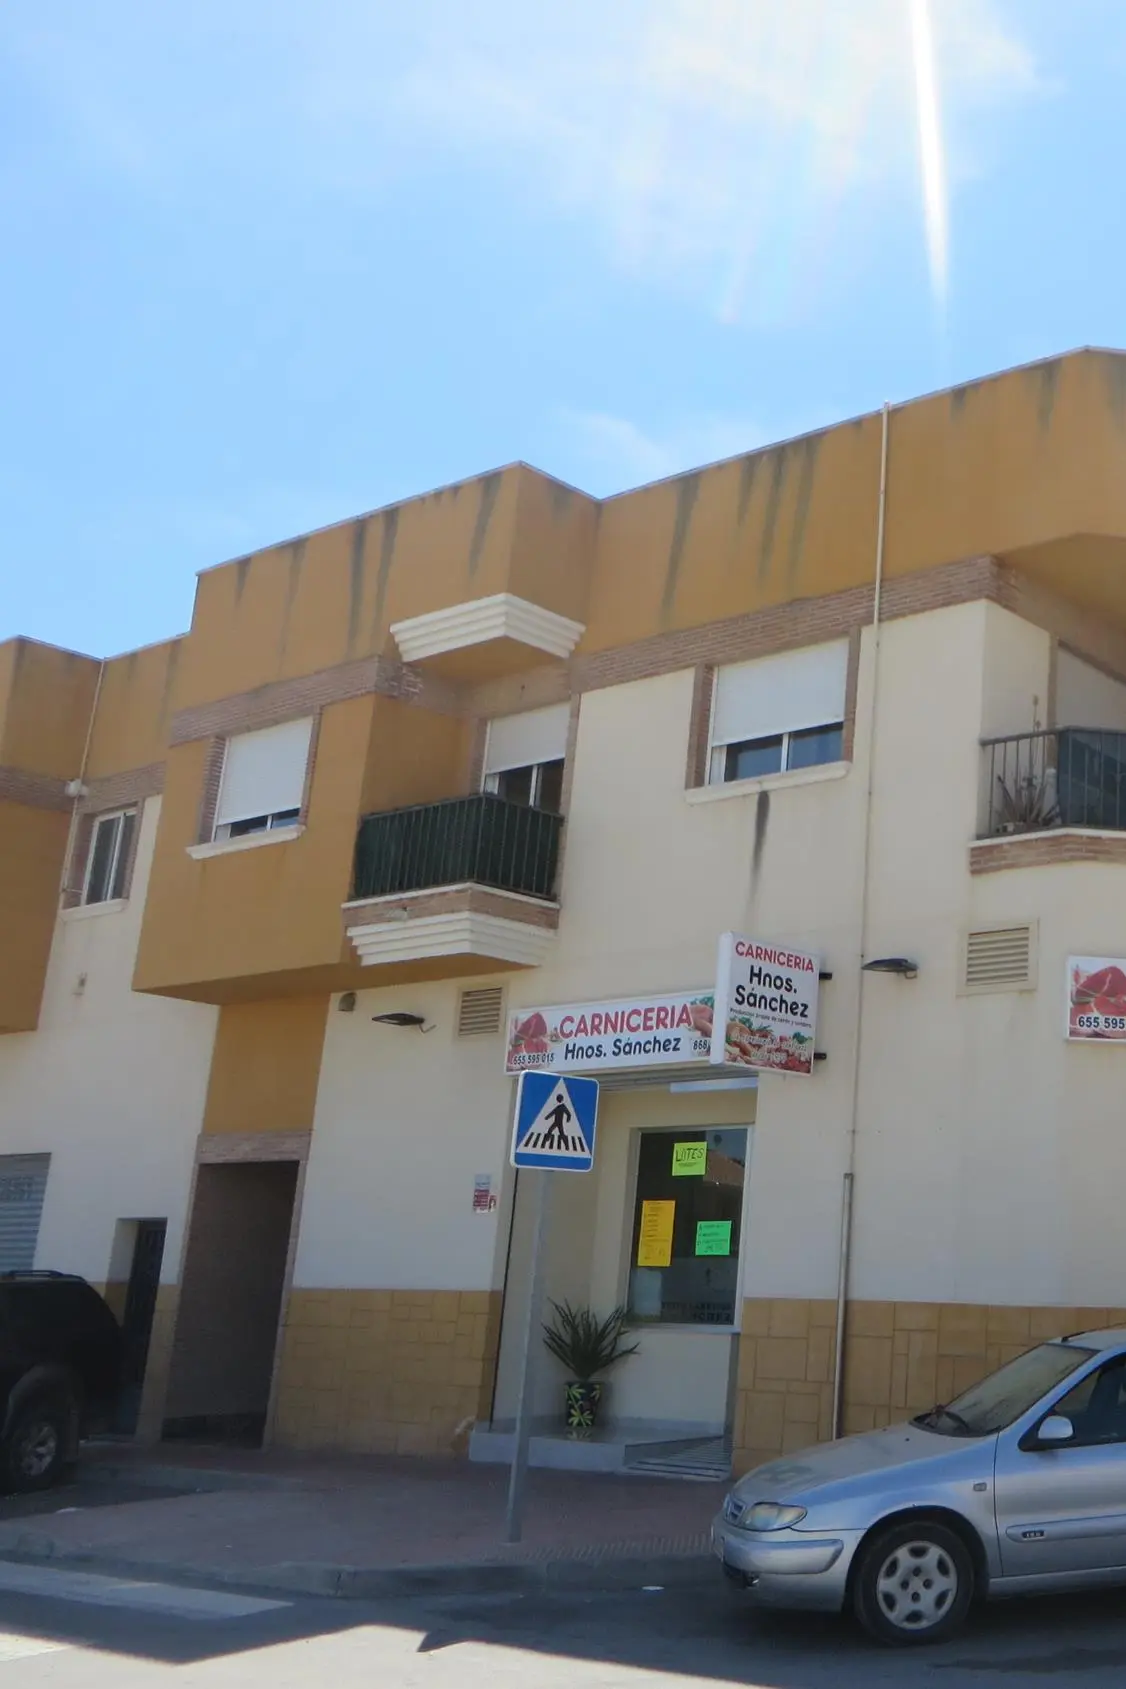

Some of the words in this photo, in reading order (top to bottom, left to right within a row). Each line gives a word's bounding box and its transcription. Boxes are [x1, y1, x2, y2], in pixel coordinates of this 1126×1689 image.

[735, 941, 814, 973] CARNICERIA
[749, 965, 797, 994] Hnos.
[734, 984, 809, 1018] Sánchez
[559, 1003, 692, 1039] CARNICERIA
[1078, 1016, 1100, 1028] 655
[1104, 1017, 1125, 1029] 595
[527, 1054, 540, 1064] 595
[564, 1042, 607, 1060] Hnos.
[612, 1036, 682, 1058] Sánchez
